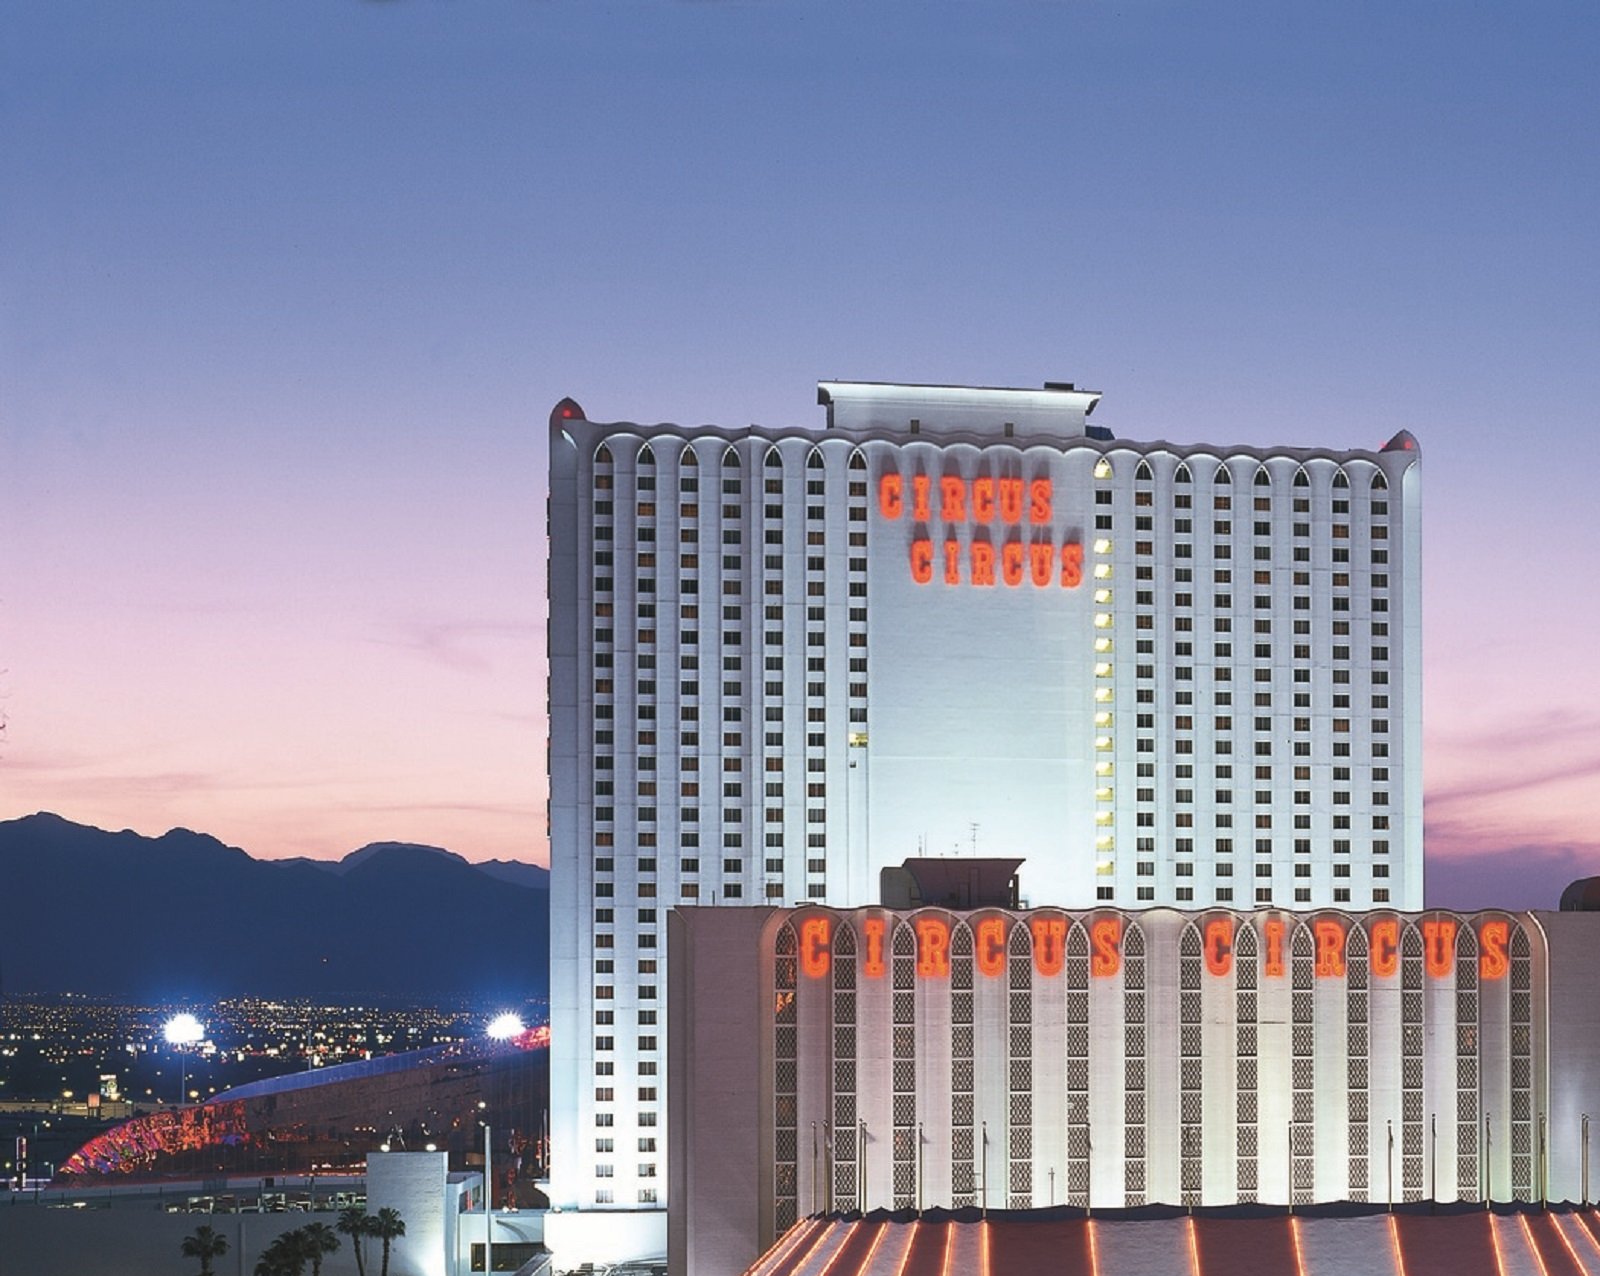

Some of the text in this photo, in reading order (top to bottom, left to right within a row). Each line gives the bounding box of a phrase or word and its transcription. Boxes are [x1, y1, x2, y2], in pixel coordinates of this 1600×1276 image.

[879, 474, 1052, 525] CIRCUS
[910, 539, 1083, 588] CIRCUS
[801, 918, 1509, 978] CIRCUS CIRCUS
